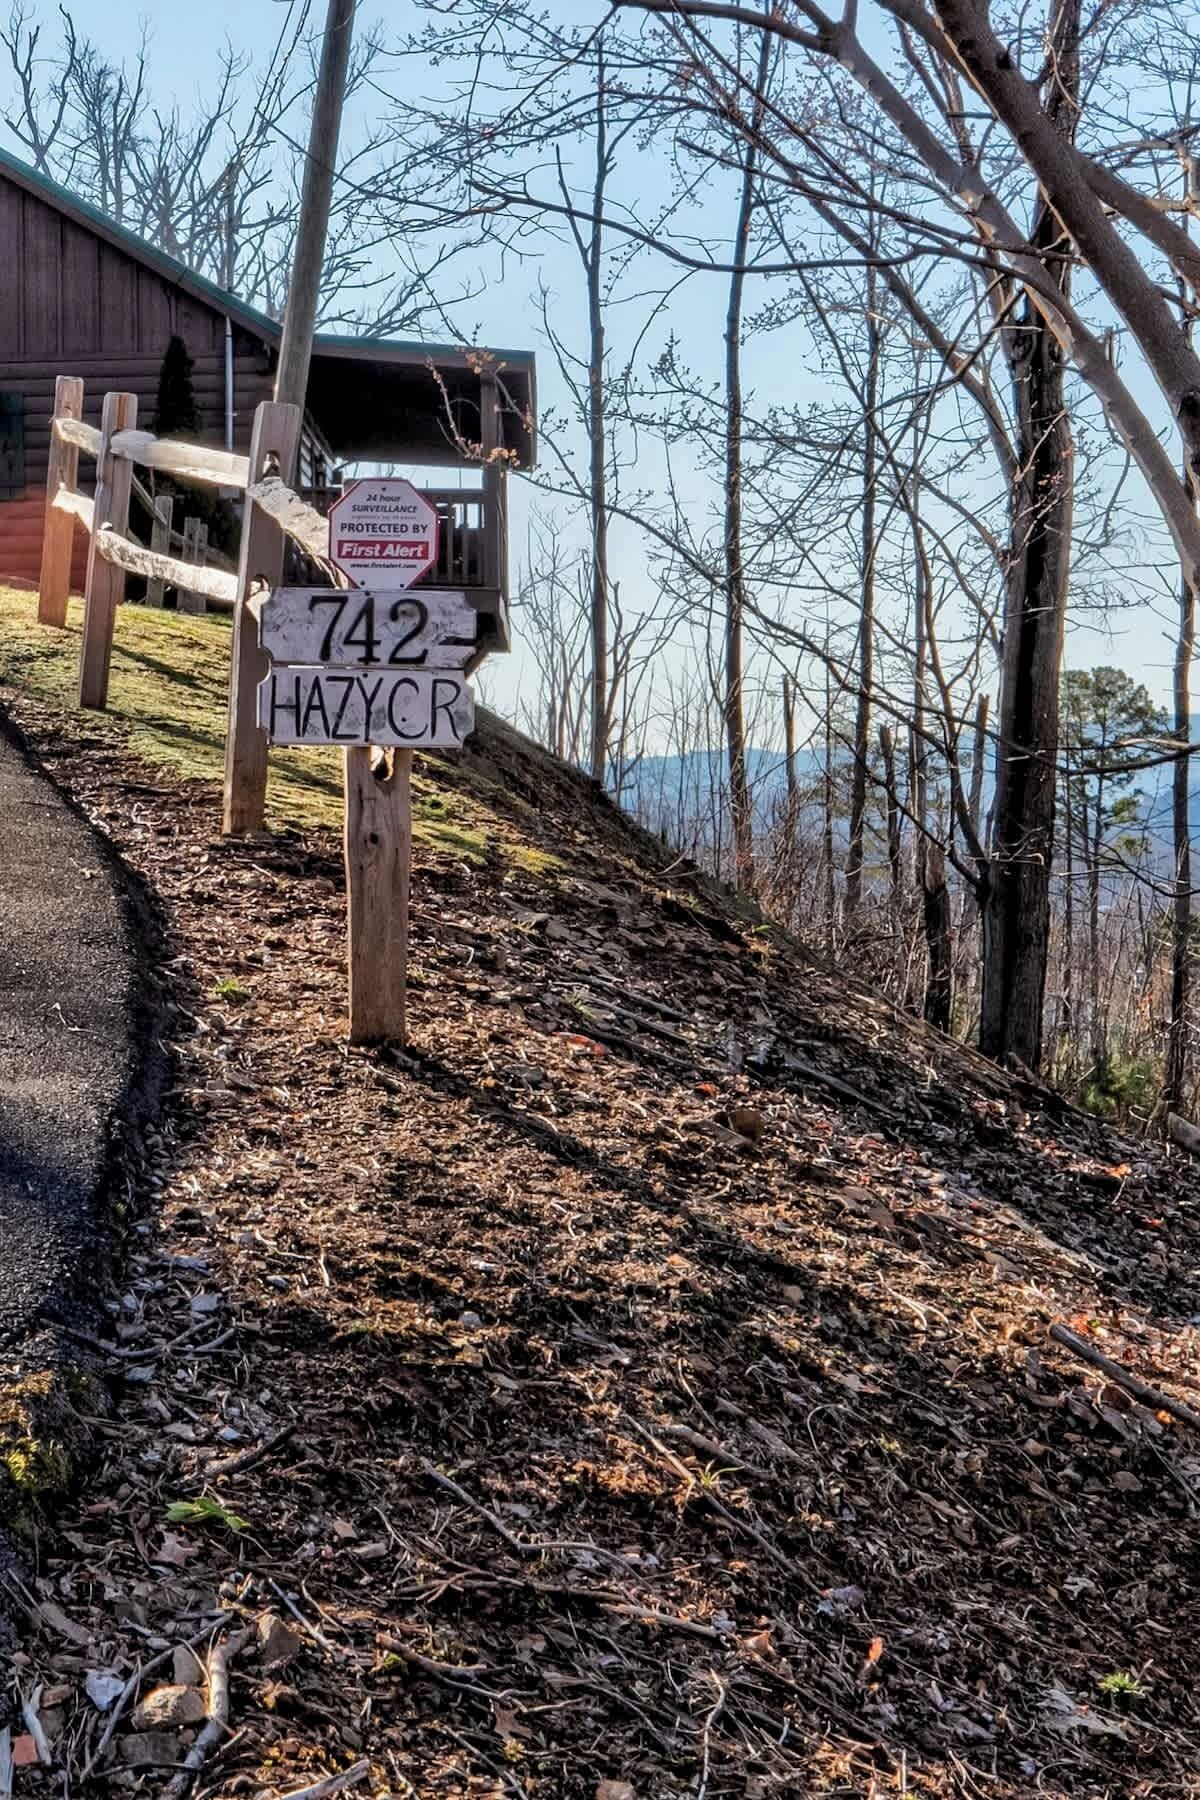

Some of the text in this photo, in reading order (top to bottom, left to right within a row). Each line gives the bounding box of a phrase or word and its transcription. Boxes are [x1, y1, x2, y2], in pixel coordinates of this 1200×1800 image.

[366, 494, 401, 502] 24 hour
[351, 504, 417, 513] SURVEILLANCE
[340, 523, 428, 534] PROTECTED BY
[341, 543, 423, 557] First Alert
[308, 596, 429, 665] 742
